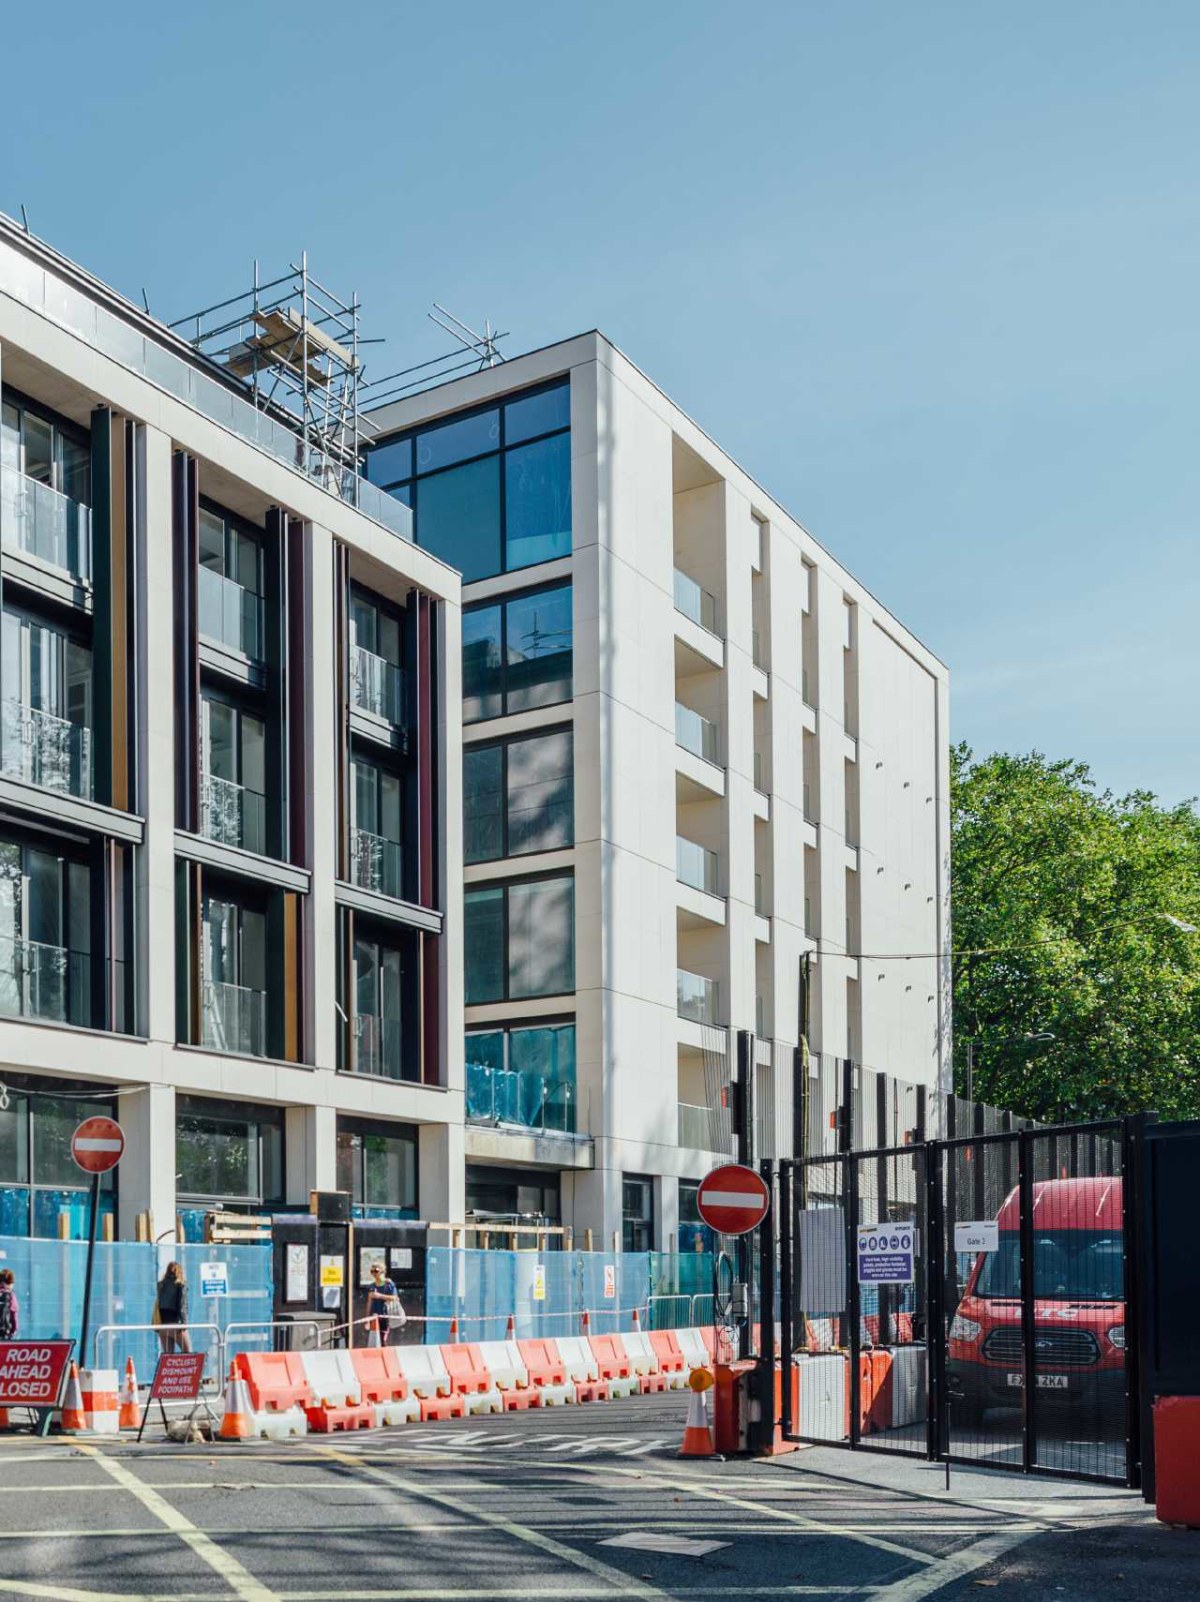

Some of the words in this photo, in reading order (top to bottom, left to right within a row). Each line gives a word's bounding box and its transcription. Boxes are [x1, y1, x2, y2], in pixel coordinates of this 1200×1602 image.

[967, 1237, 980, 1245] Gate
[6, 1348, 52, 1362] ROAD
[166, 1358, 197, 1367] CYCLISTS
[161, 1366, 198, 1376] DISMOUNT
[162, 1377, 178, 1385] AND
[179, 1376, 192, 1384] USE
[1041, 1376, 1065, 1387] ZKA
[157, 1385, 194, 1394] FOOTPATH
